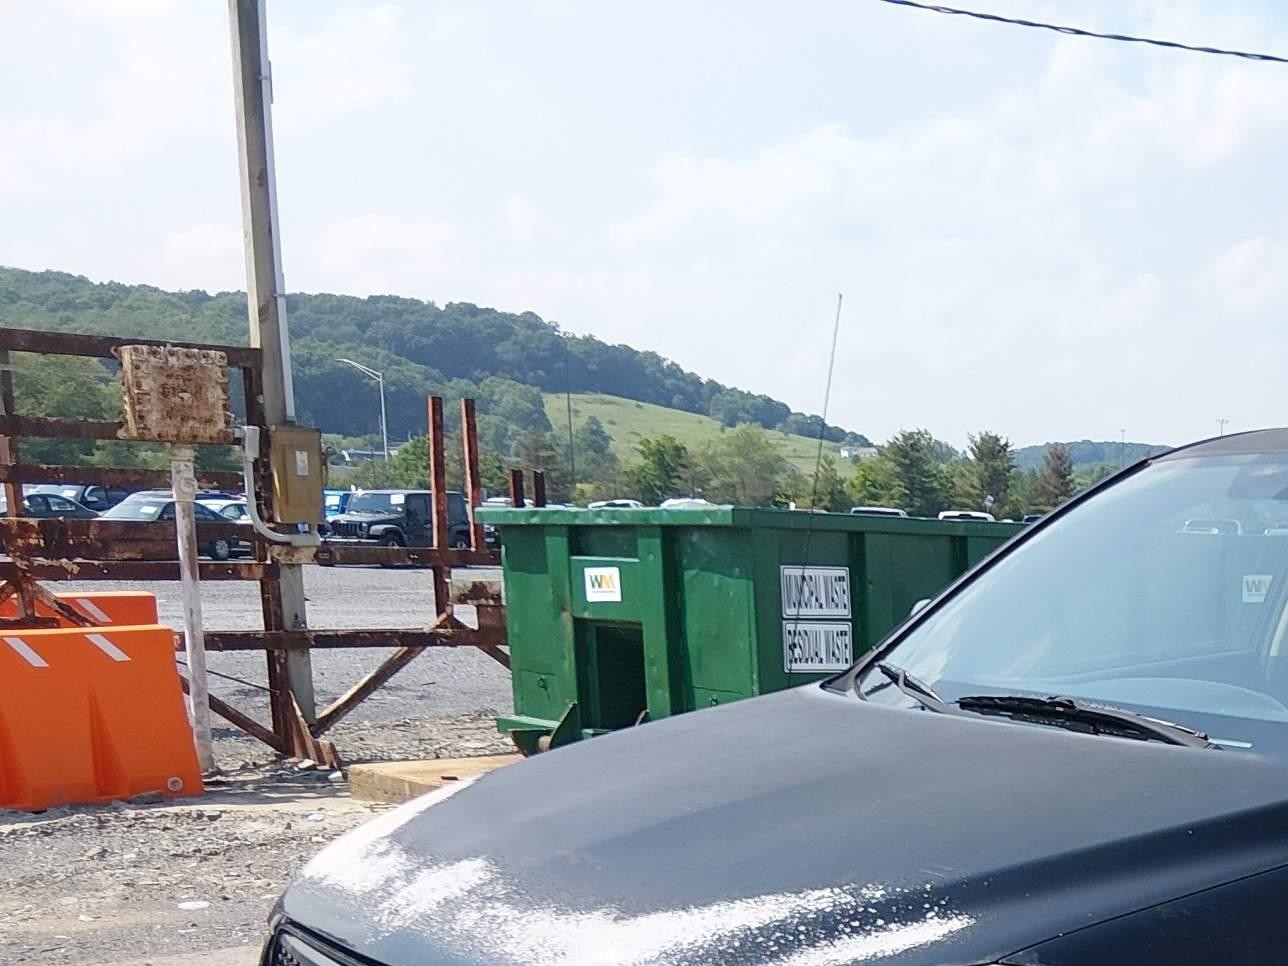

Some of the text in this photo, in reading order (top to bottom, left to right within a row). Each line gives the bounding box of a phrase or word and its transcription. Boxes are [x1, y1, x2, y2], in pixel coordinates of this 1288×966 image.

[588, 574, 617, 590] WM
[823, 575, 848, 610] WASTE
[786, 629, 849, 665] RESIDUAL WASTE
